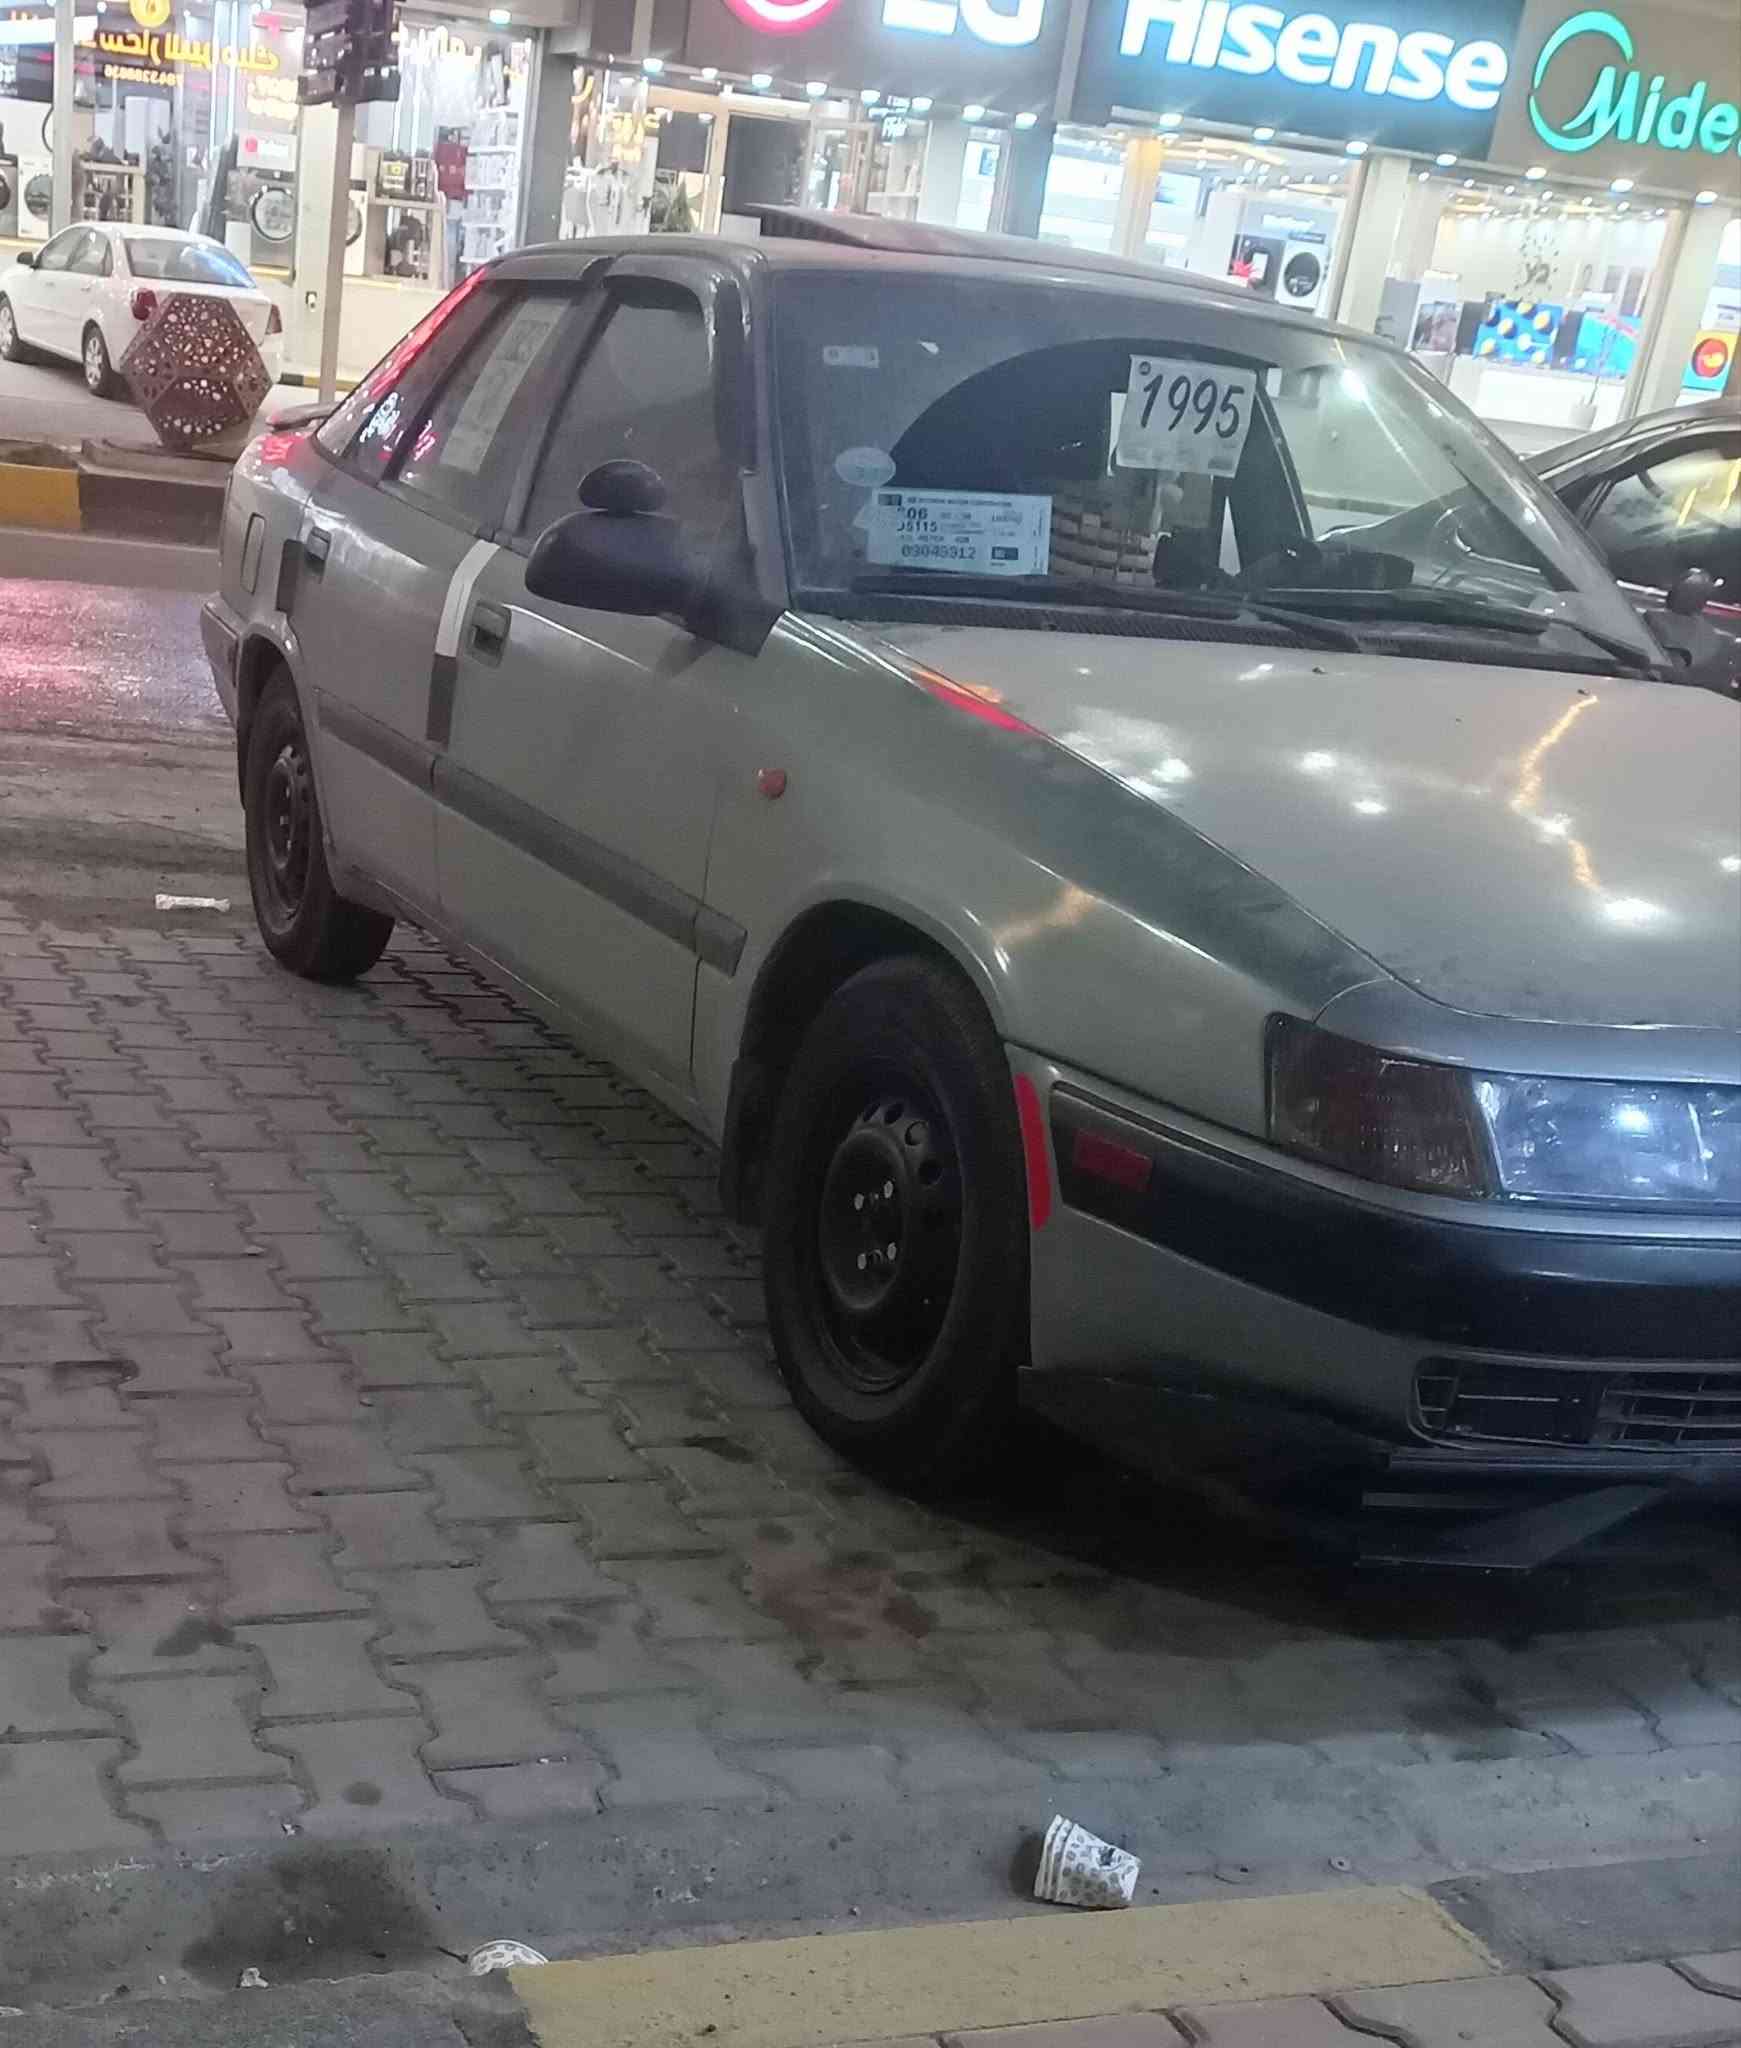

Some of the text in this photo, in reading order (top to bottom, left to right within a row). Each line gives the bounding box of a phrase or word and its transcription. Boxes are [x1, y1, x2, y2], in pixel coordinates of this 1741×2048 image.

[1119, 0, 1508, 110] Hisense
[1529, 66, 1741, 154] Mide
[1141, 374, 1245, 438] 1995
